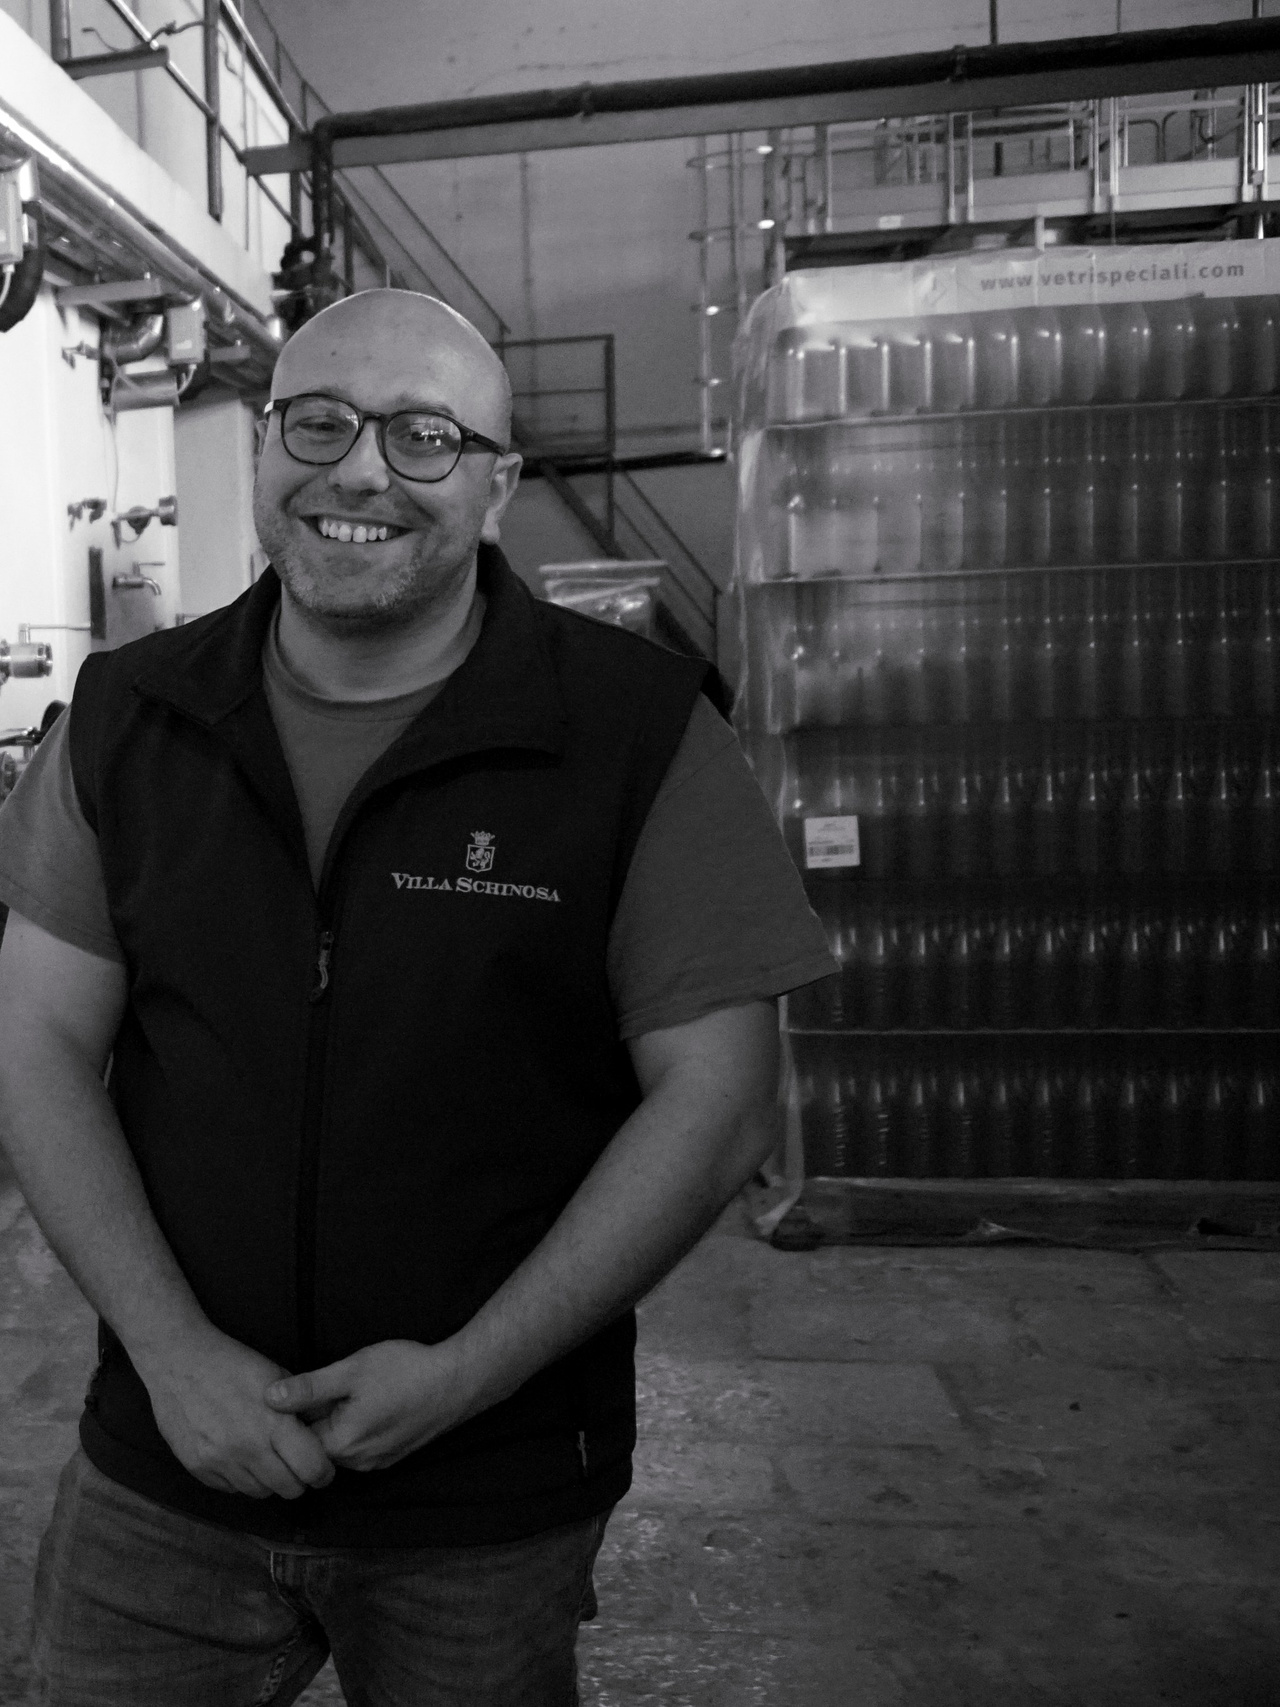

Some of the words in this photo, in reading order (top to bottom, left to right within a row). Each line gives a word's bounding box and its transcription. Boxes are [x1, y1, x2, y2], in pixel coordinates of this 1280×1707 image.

[980, 262, 1246, 291] wwwvetrispeciali.com
[391, 872, 453, 891] VILLA
[455, 877, 561, 902] SCHINOSA
